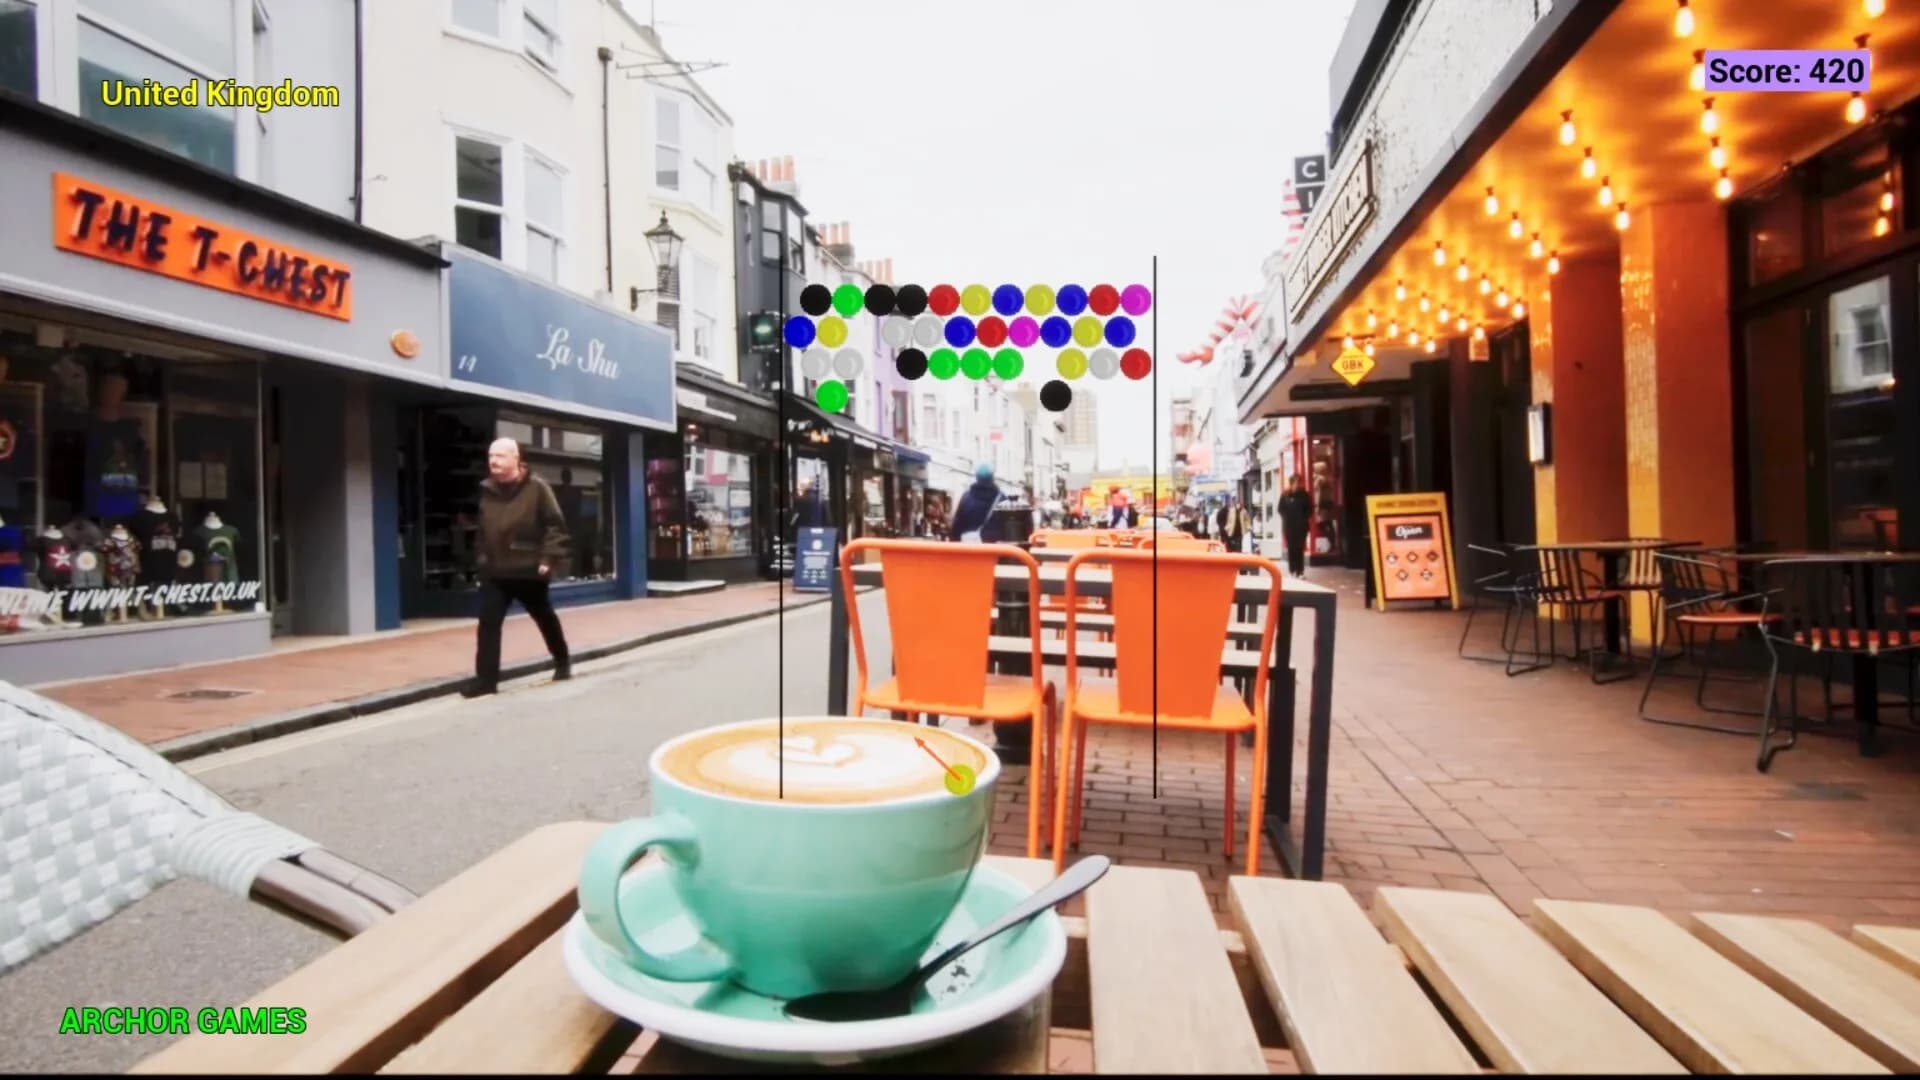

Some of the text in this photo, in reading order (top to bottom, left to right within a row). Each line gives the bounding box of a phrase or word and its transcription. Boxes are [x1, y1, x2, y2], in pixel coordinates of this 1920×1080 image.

[69, 188, 351, 308] THE T-CHEST
[536, 324, 573, 371] La
[68, 580, 262, 613] WWW.T-CHEST.CO.UK
